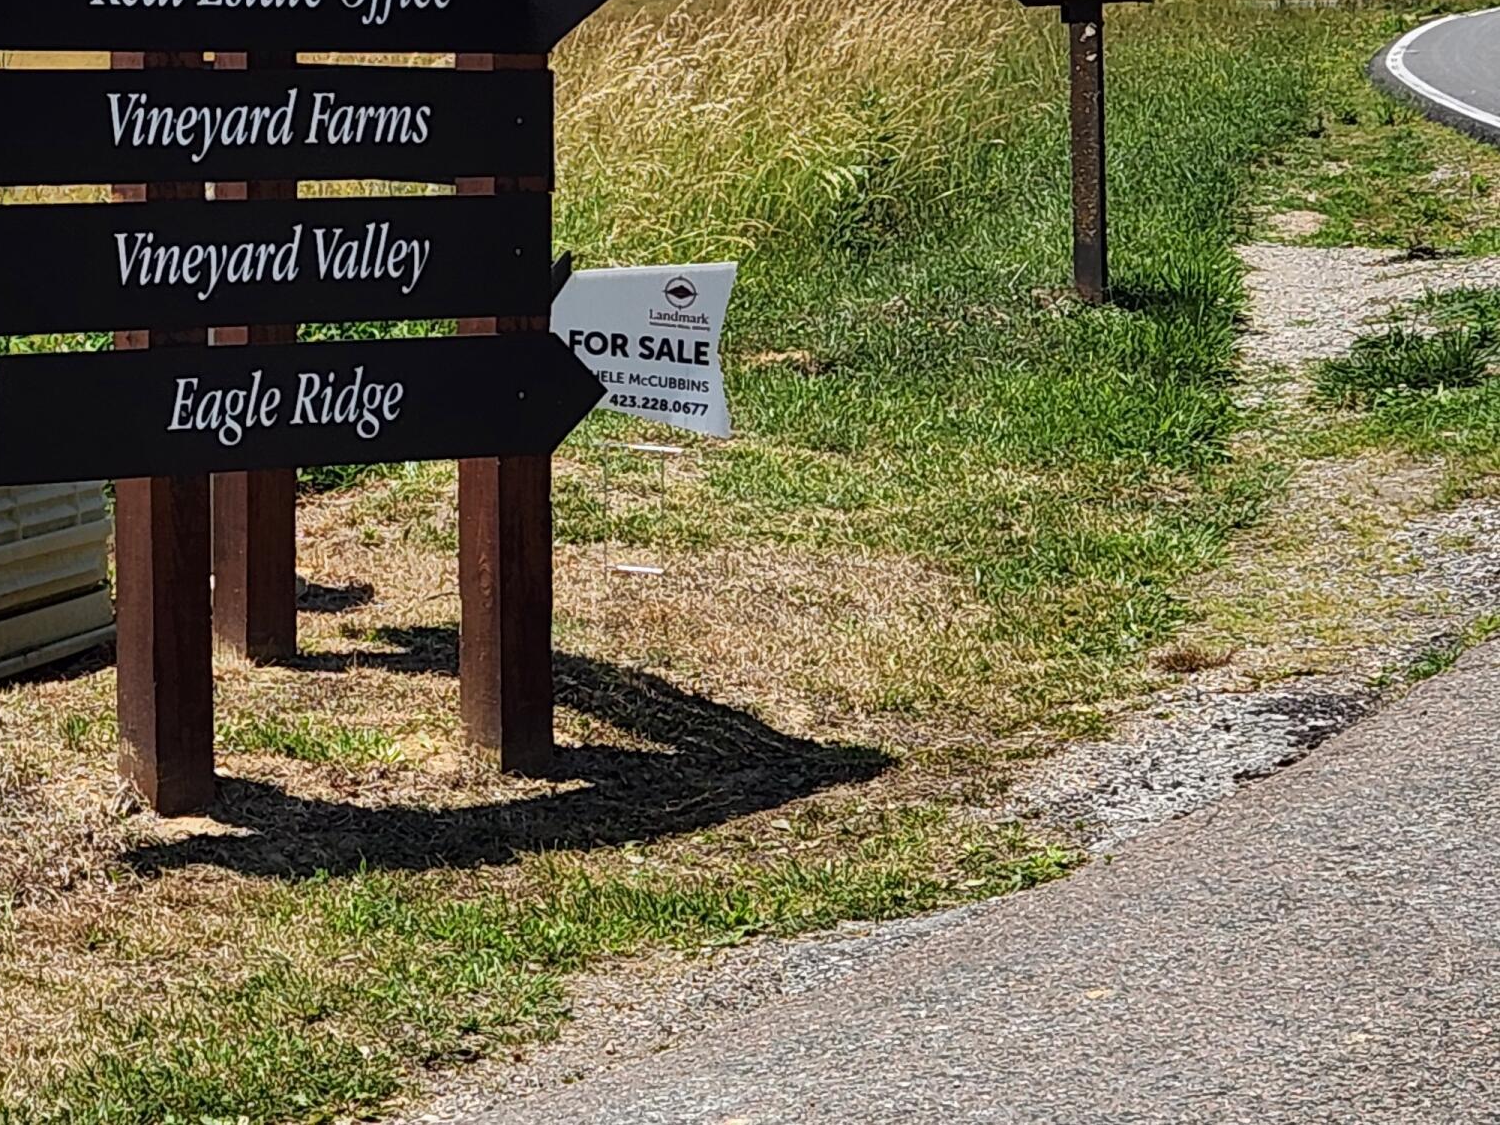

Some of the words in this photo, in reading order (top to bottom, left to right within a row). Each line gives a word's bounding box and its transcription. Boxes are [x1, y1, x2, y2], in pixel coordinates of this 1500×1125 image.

[106, 87, 298, 163] Vineyard
[304, 92, 432, 145] Farms
[113, 223, 303, 301] Vineyard
[312, 221, 431, 294] Valley
[649, 308, 709, 325] Landmark
[569, 329, 629, 358] FOR
[638, 335, 710, 366] SALE
[628, 372, 709, 393] McCUBBINS
[167, 369, 281, 446] Eagle
[289, 365, 404, 439] Ridge
[609, 393, 709, 416] 423.228.0677
